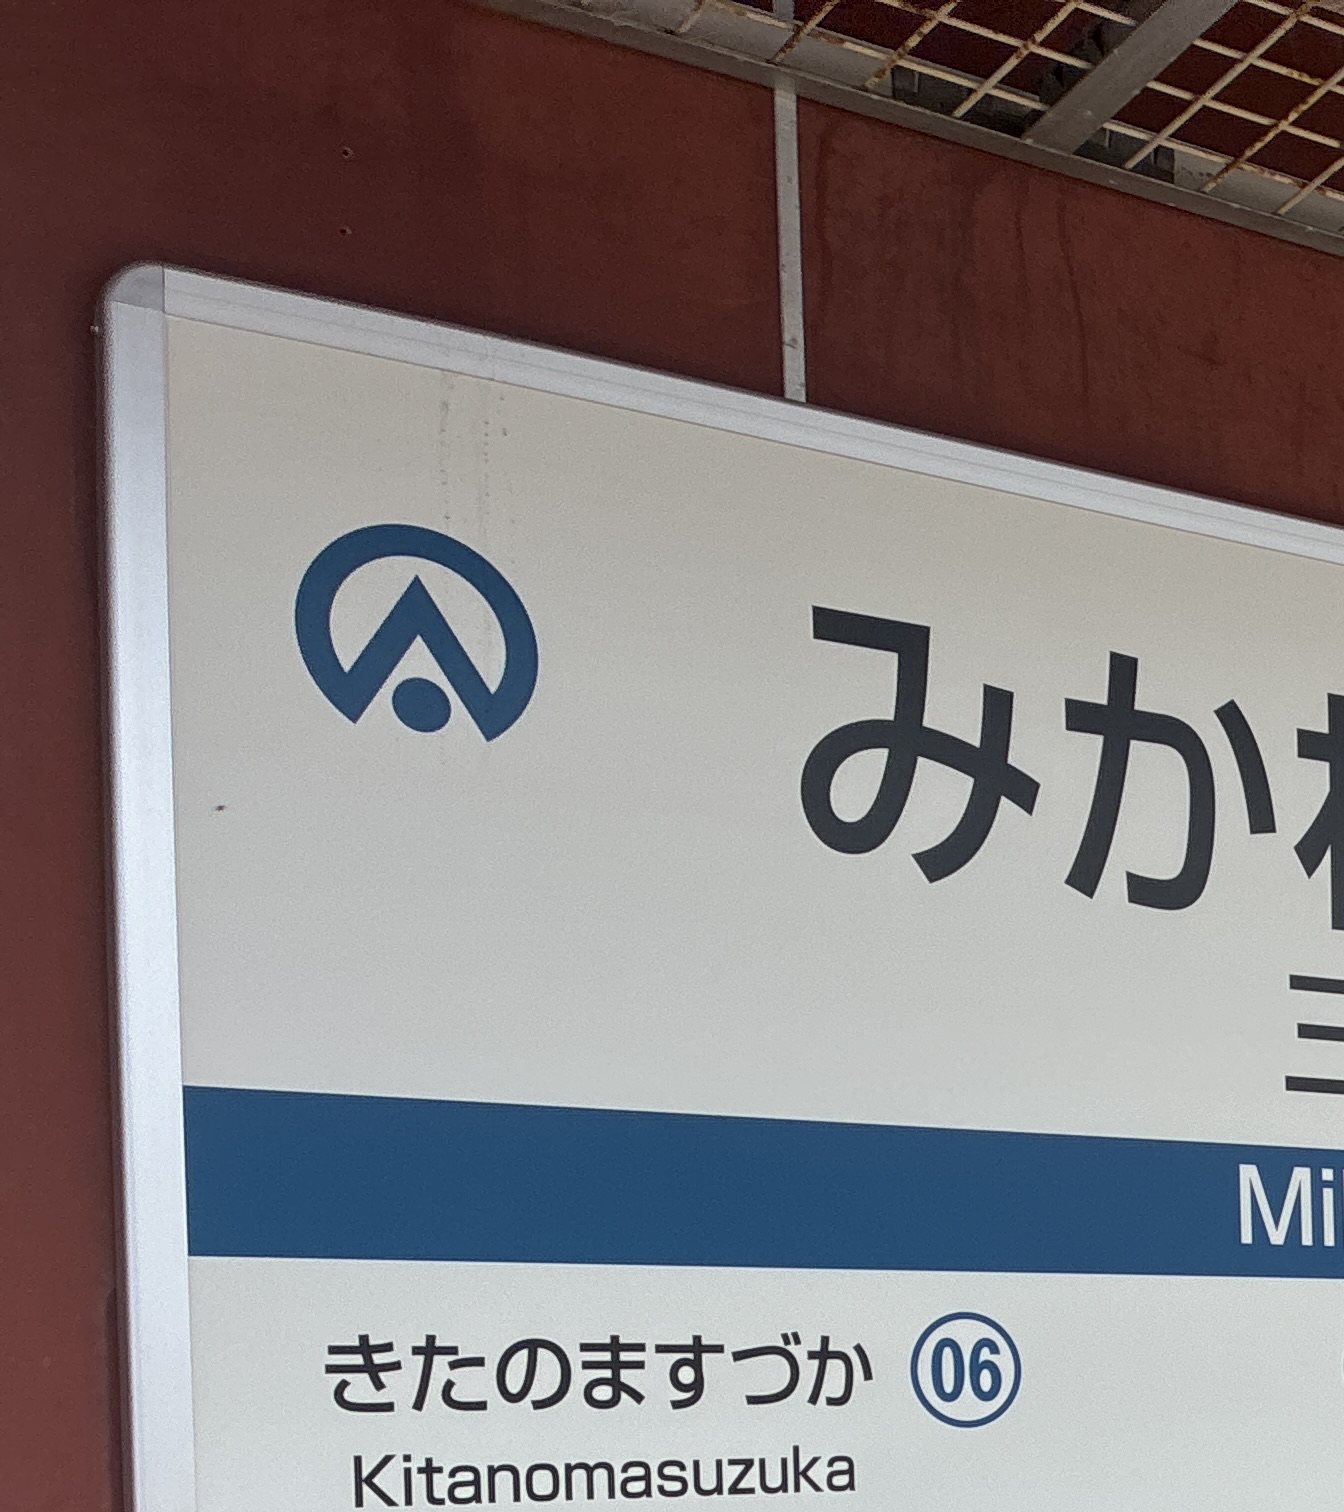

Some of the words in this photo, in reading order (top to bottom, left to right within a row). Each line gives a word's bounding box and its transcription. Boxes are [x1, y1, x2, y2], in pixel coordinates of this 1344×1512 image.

[325, 1331, 874, 1414] きたのますづか
[931, 1336, 1001, 1404] 06
[353, 1445, 857, 1509] Kitanomasuzuka
